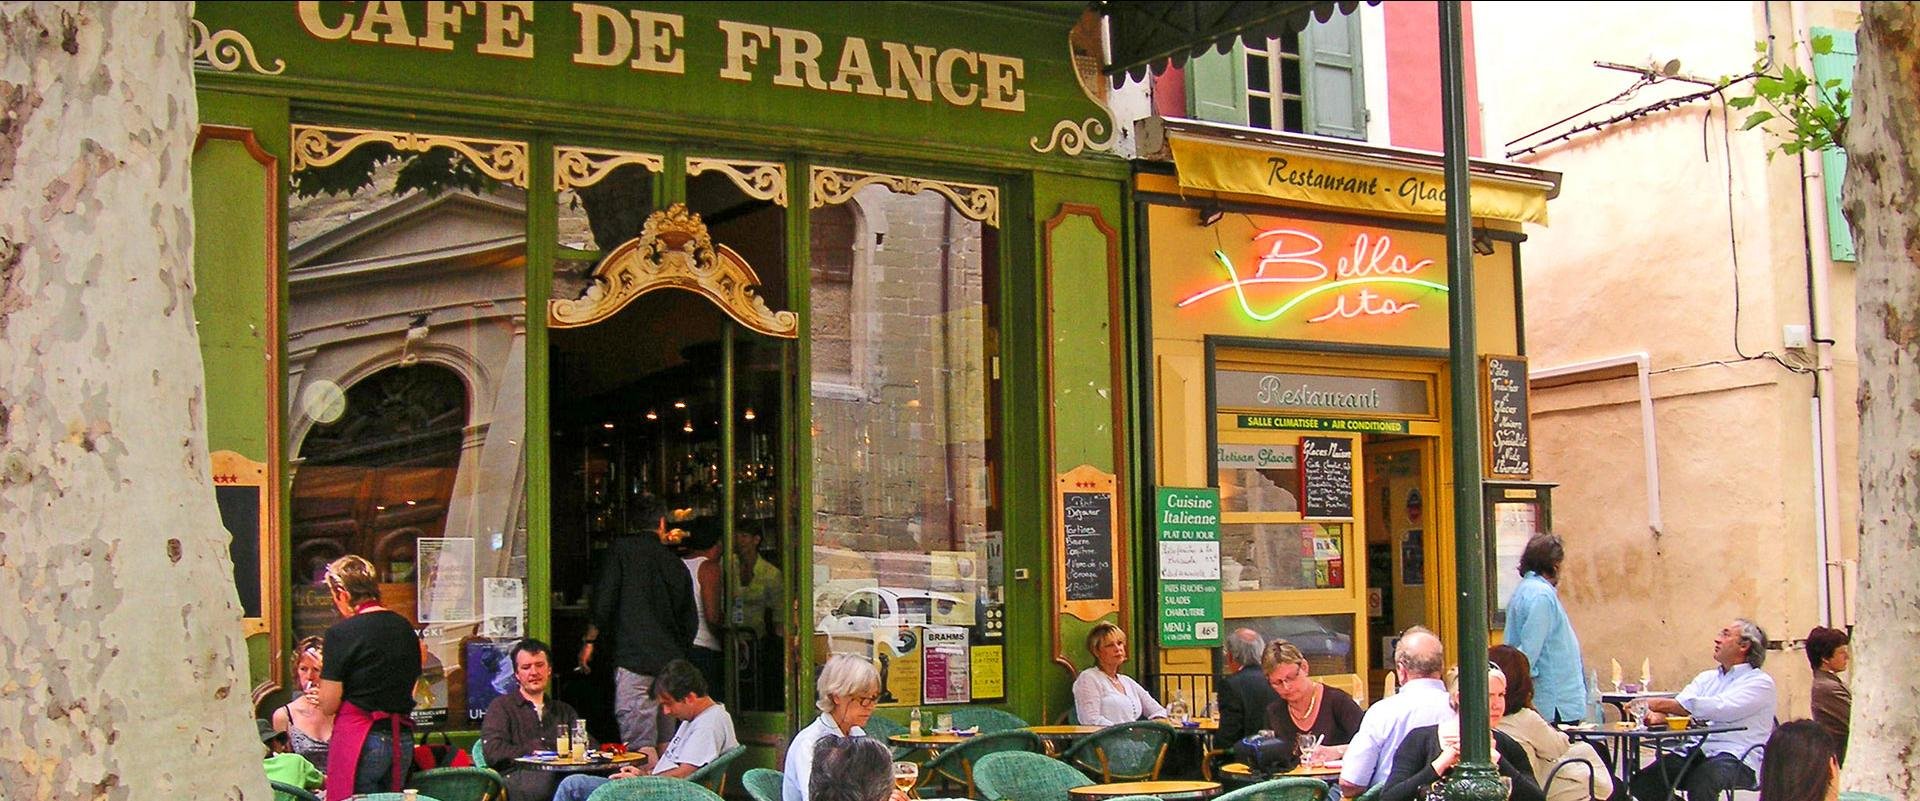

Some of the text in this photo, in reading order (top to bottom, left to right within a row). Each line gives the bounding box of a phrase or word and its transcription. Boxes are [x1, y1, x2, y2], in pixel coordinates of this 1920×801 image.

[572, 3, 684, 75] DE
[718, 20, 1025, 112] FRANCE
[1267, 157, 1377, 196] Restaurant
[1398, 177, 1447, 206] Glac
[1218, 230, 1436, 288] Bella
[1257, 375, 1380, 409] Restaurant
[1247, 416, 1401, 431] SALLE CLIMATISÉE AIR CONDITIONED
[1217, 447, 1255, 462] Artisan
[1258, 448, 1293, 467] Glacier
[1168, 494, 1213, 508] Cuisine
[1163, 510, 1216, 524] Italienne
[1065, 524, 1096, 534] Tartines
[1163, 531, 1215, 539] PLAT DU JOUR
[1165, 596, 1191, 605] SALADES
[1165, 608, 1205, 617] CHARCUTERIE
[414, 628, 443, 637] YCKI
[1164, 622, 1185, 632] MENU
[928, 632, 965, 641] BRAHMS
